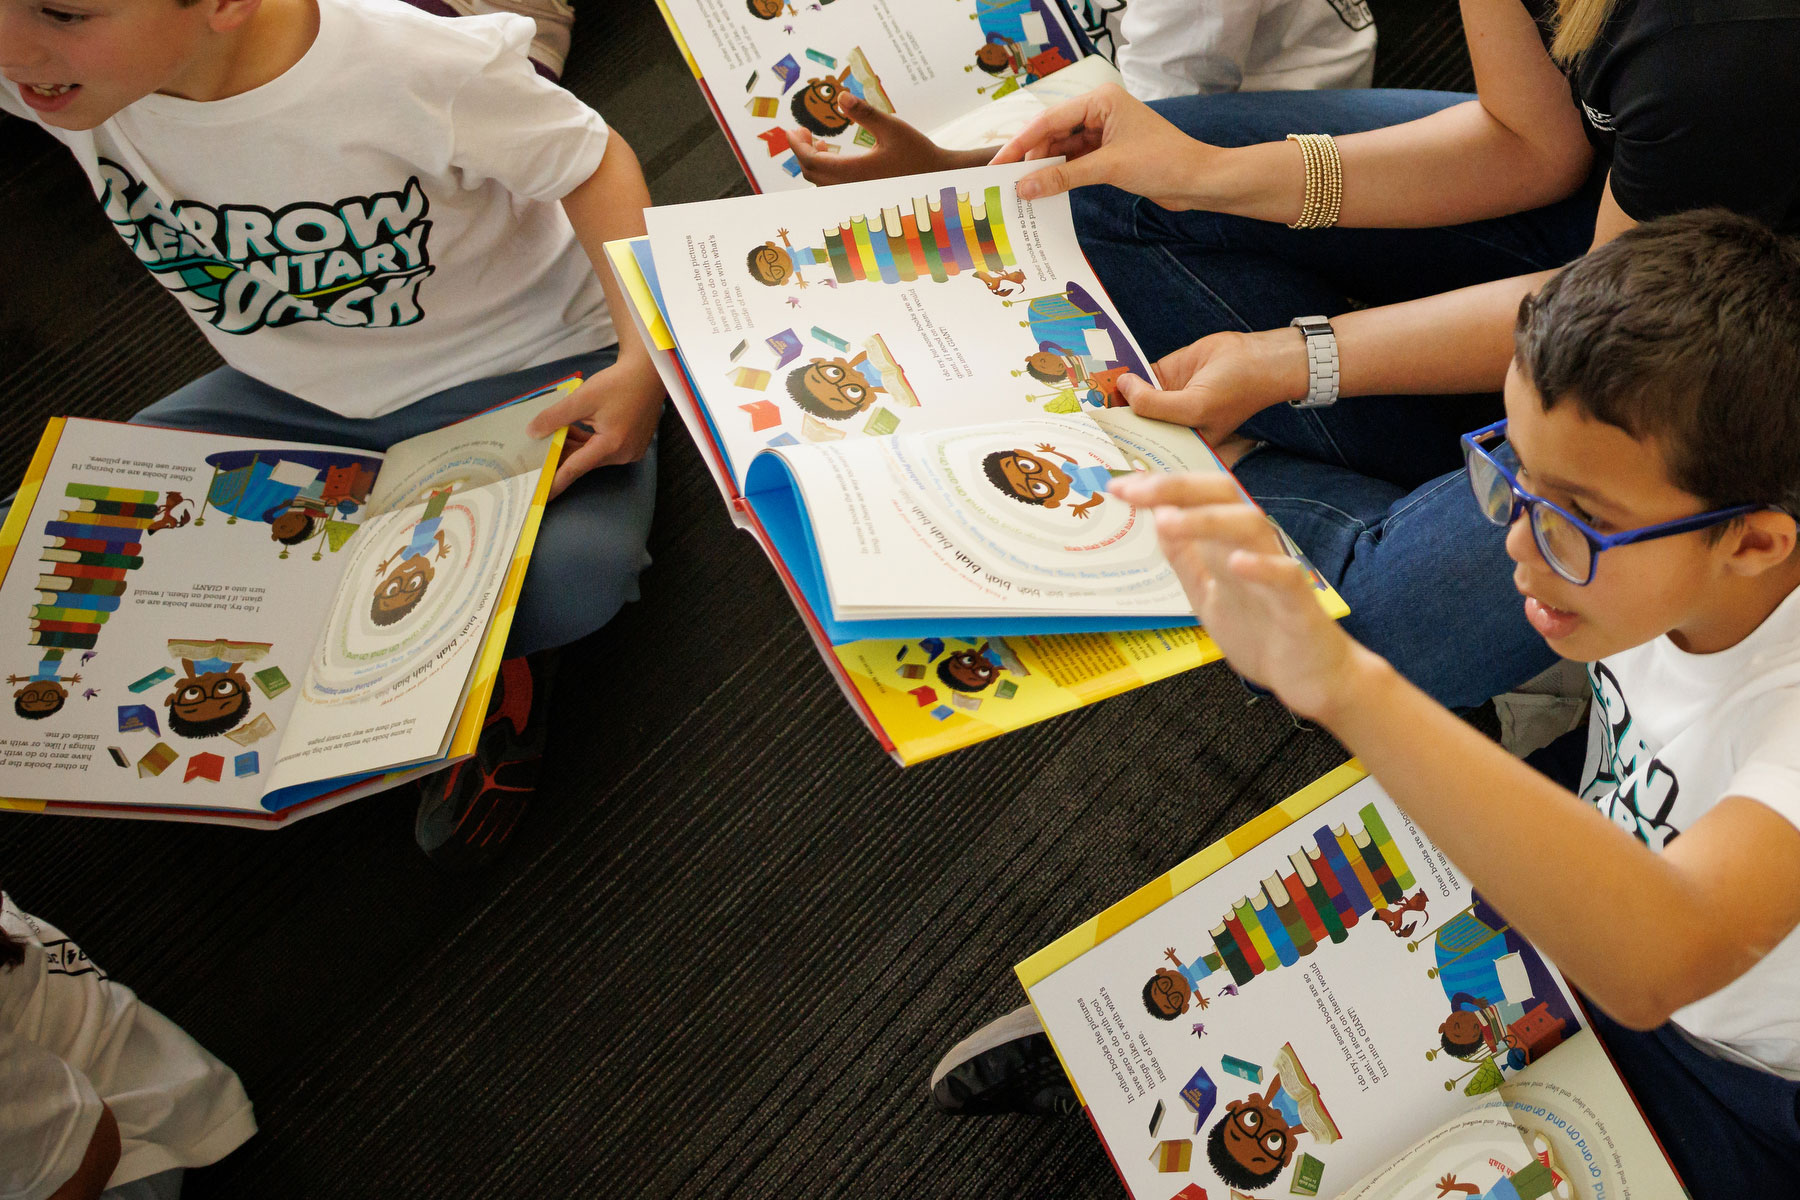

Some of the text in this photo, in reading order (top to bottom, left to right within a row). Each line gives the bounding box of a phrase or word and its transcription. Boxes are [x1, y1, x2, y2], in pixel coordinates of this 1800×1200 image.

[928, 526, 1011, 590] blah blah blah
[459, 615, 478, 637] blah
[435, 638, 458, 660] blah
[412, 659, 433, 678] blah
[392, 675, 411, 691] blah
[4, 750, 23, 759] with
[8, 760, 22, 768] the
[24, 761, 52, 770] books
[79, 764, 89, 772] In
[1409, 826, 1417, 836] so
[1414, 836, 1424, 849] are
[1421, 849, 1438, 875] books
[1437, 852, 1460, 891] rather use
[1435, 874, 1450, 897] Other
[1303, 973, 1311, 983] so
[1309, 962, 1326, 988] would
[1099, 987, 1115, 1012] what's
[1309, 984, 1319, 997] are
[1316, 998, 1333, 1024] books
[1328, 991, 1341, 1015] them,
[1112, 1011, 1125, 1031] with
[1339, 1014, 1348, 1026] on
[1347, 1007, 1366, 1037] GIANT!
[1122, 1031, 1130, 1040] or
[1330, 1023, 1345, 1046] some
[1343, 1026, 1360, 1049] stood
[1077, 998, 1135, 1104] In other books the pictures
[1090, 998, 1146, 1098] have zero to do with cool
[1129, 1039, 1140, 1060] like,
[1138, 1031, 1167, 1083] inside of me.
[1341, 1045, 1353, 1061] but
[1368, 1043, 1379, 1060] into
[1350, 1059, 1360, 1074] try,
[1358, 1054, 1367, 1062] if
[1140, 1063, 1156, 1090] things
[1364, 1060, 1380, 1084] giant,
[1377, 1059, 1389, 1078] turn
[1357, 1074, 1366, 1086] do
[1514, 1102, 1532, 1113] and
[1532, 1106, 1546, 1116] on
[1584, 1107, 1596, 1119] and
[1545, 1112, 1567, 1129] and
[1566, 1124, 1580, 1141] on
[1575, 1139, 1593, 1162] and
[1603, 1135, 1615, 1149] and
[1588, 1161, 1602, 1178] on
